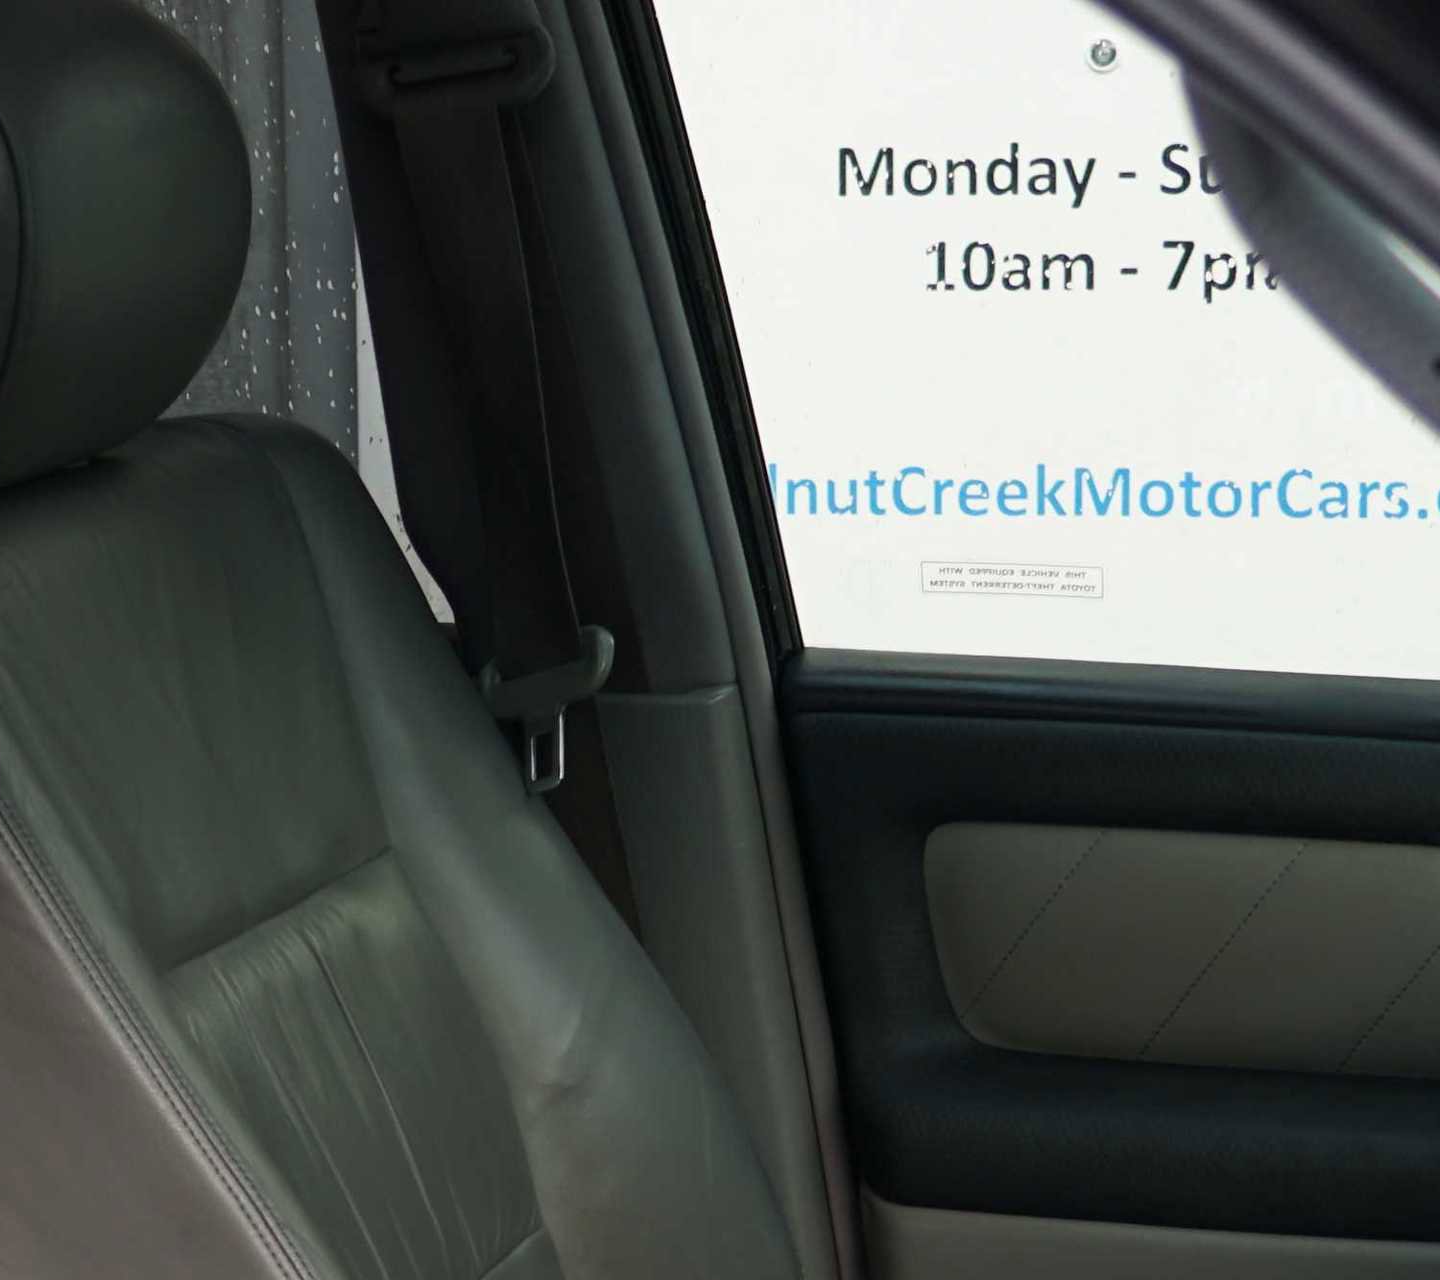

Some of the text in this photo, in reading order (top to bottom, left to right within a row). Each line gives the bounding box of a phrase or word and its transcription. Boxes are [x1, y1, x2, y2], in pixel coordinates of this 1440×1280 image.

[839, 142, 1096, 208] Monday
[1160, 143, 1223, 194] Su
[926, 241, 1095, 291] 10am
